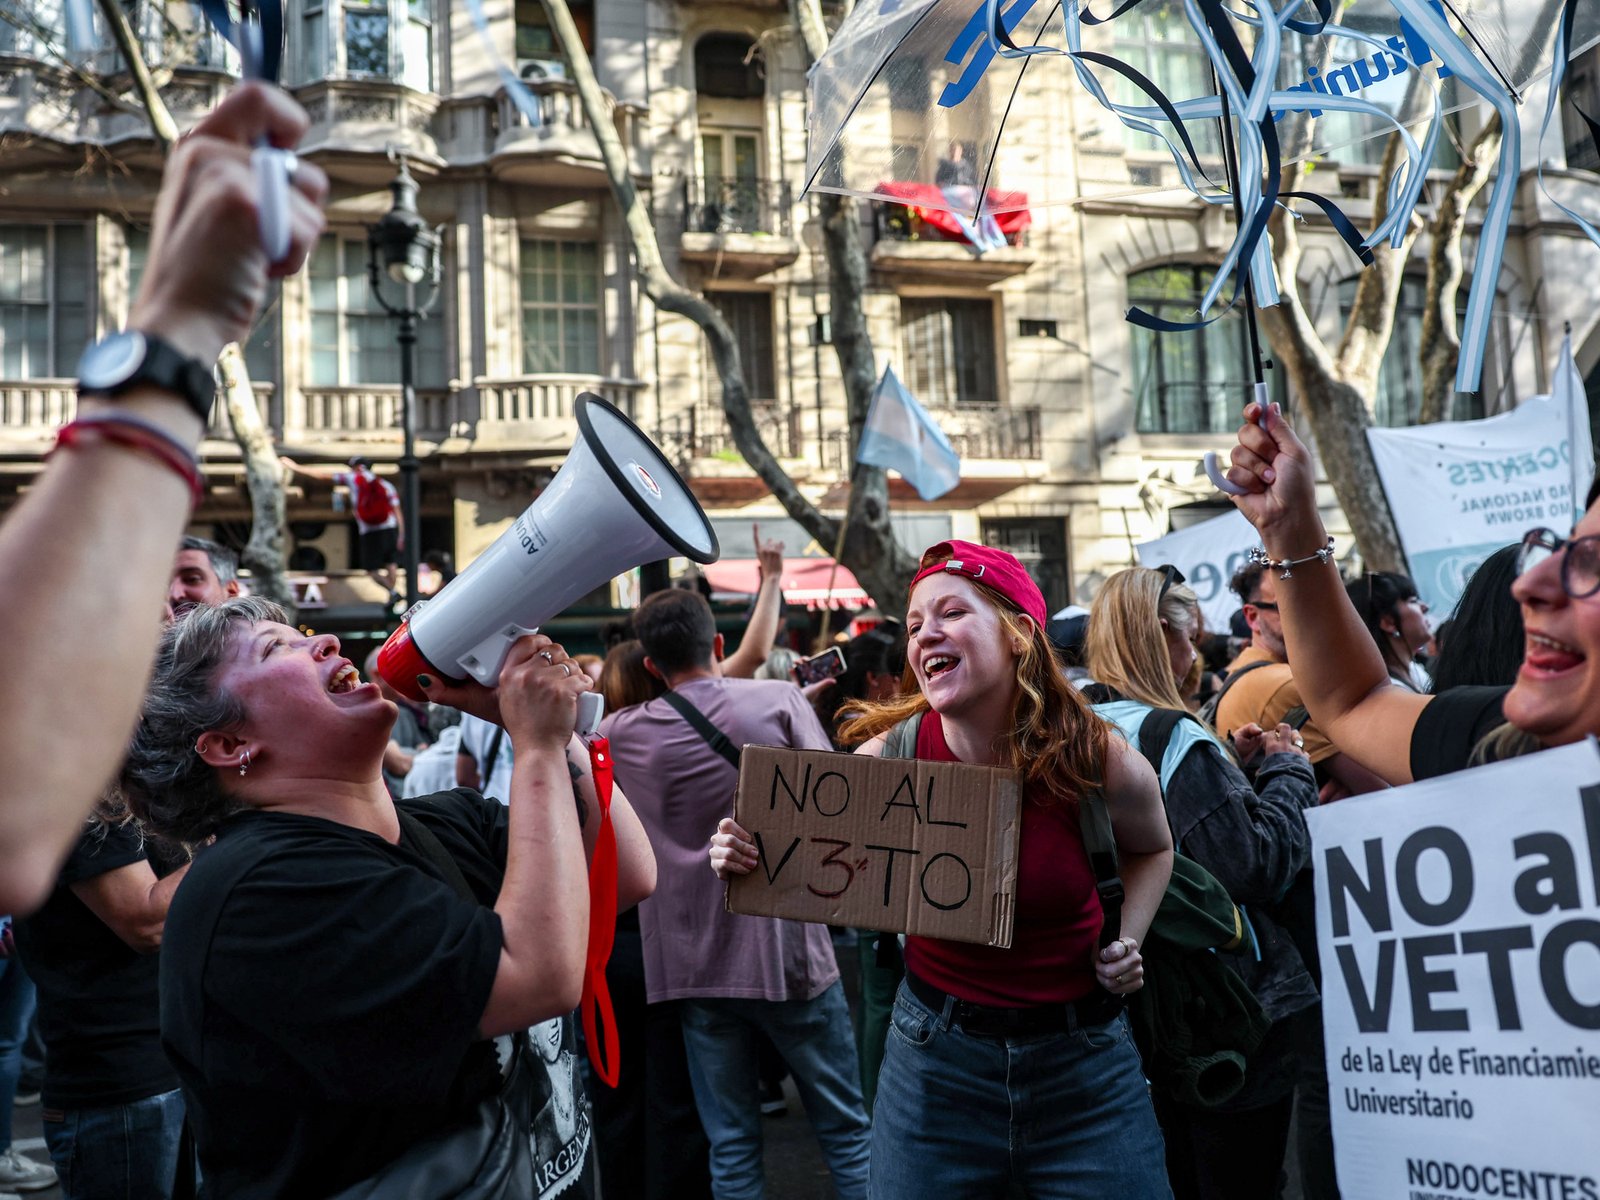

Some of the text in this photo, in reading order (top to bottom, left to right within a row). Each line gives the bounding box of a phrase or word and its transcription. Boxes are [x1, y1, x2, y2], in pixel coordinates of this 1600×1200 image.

[770, 763, 968, 829] NO AL
[1324, 783, 1600, 938] NO al
[1334, 917, 1600, 1033] VETO
[1341, 1046, 1363, 1072] de
[1367, 1047, 1385, 1073] la
[1388, 1048, 1423, 1081] Ley
[1428, 1046, 1453, 1075] de
[1344, 1085, 1474, 1120] Universitario
[1406, 1157, 1600, 1200] NODOCENTES
